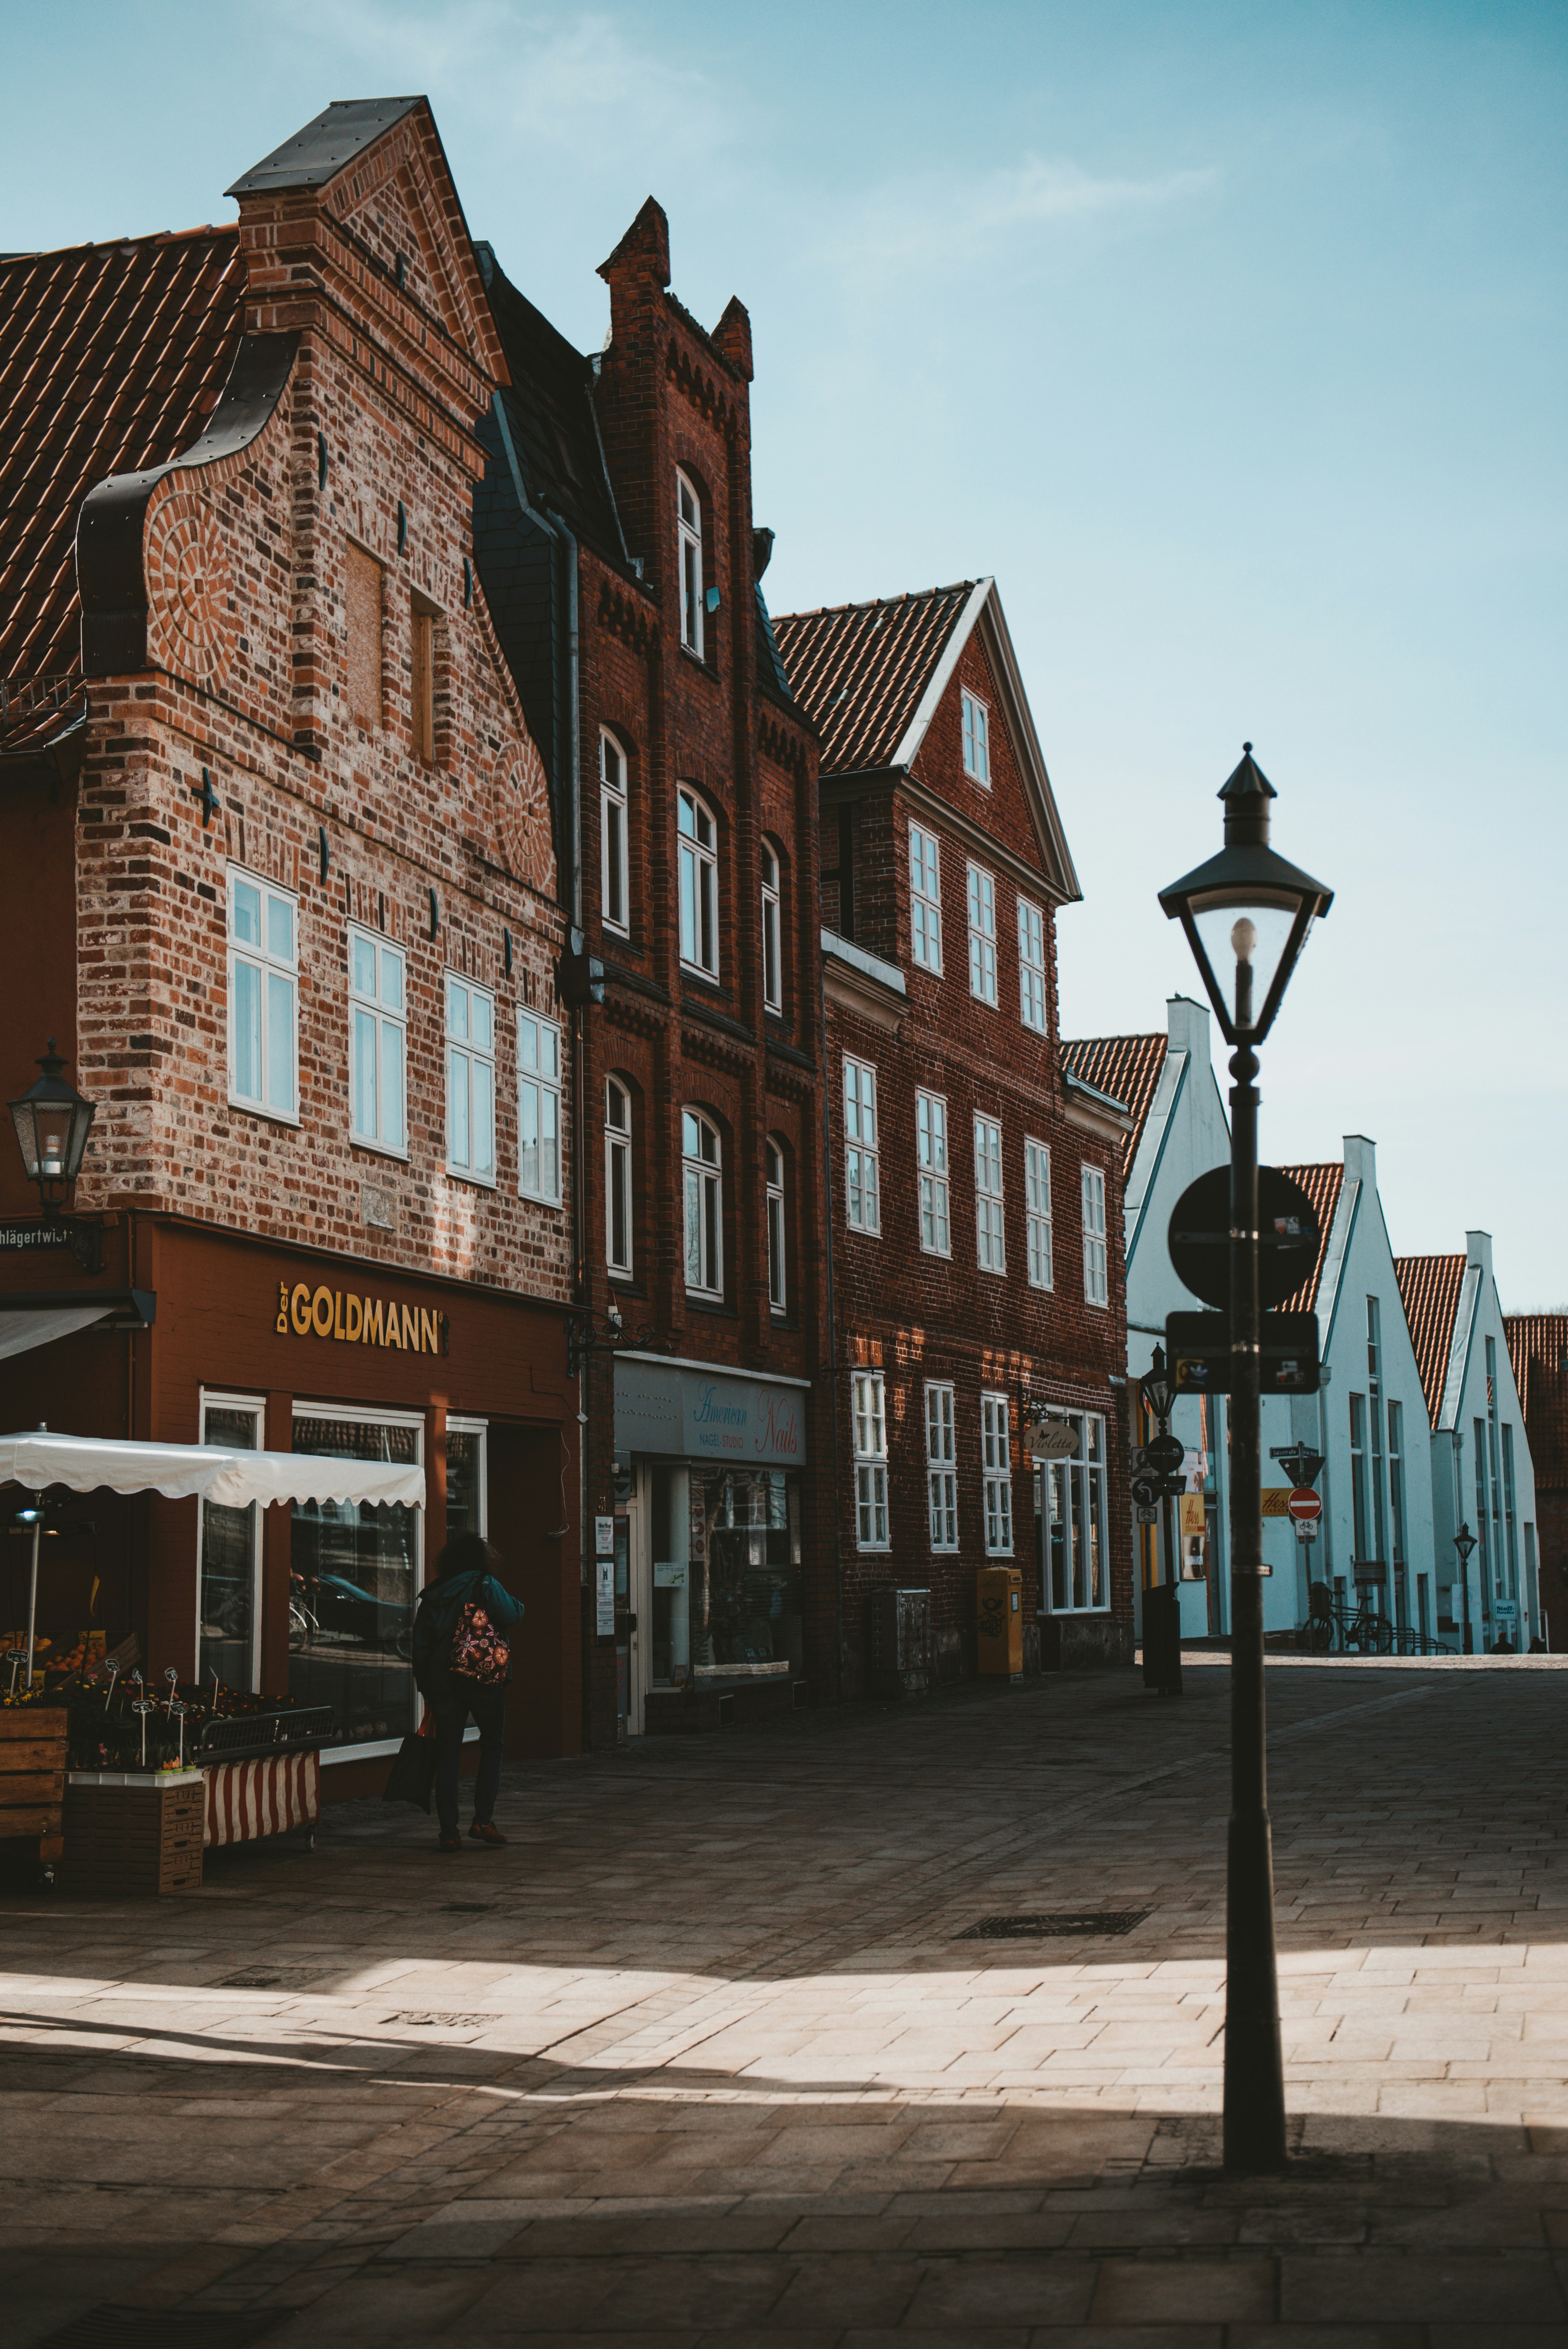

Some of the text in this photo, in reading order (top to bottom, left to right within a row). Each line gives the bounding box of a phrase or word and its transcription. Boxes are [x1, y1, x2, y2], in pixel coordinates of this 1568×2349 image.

[0, 1228, 73, 1248] hlägertwiet
[277, 1281, 288, 1333] Der
[291, 1283, 438, 1354] GOLDMANN
[694, 1380, 797, 1454] American Nails
[700, 1433, 744, 1449] NAGEL-STUDIO
[1028, 1431, 1072, 1449] Violetta
[598, 1496, 606, 1512] 31
[1185, 1499, 1199, 1524] Hess
